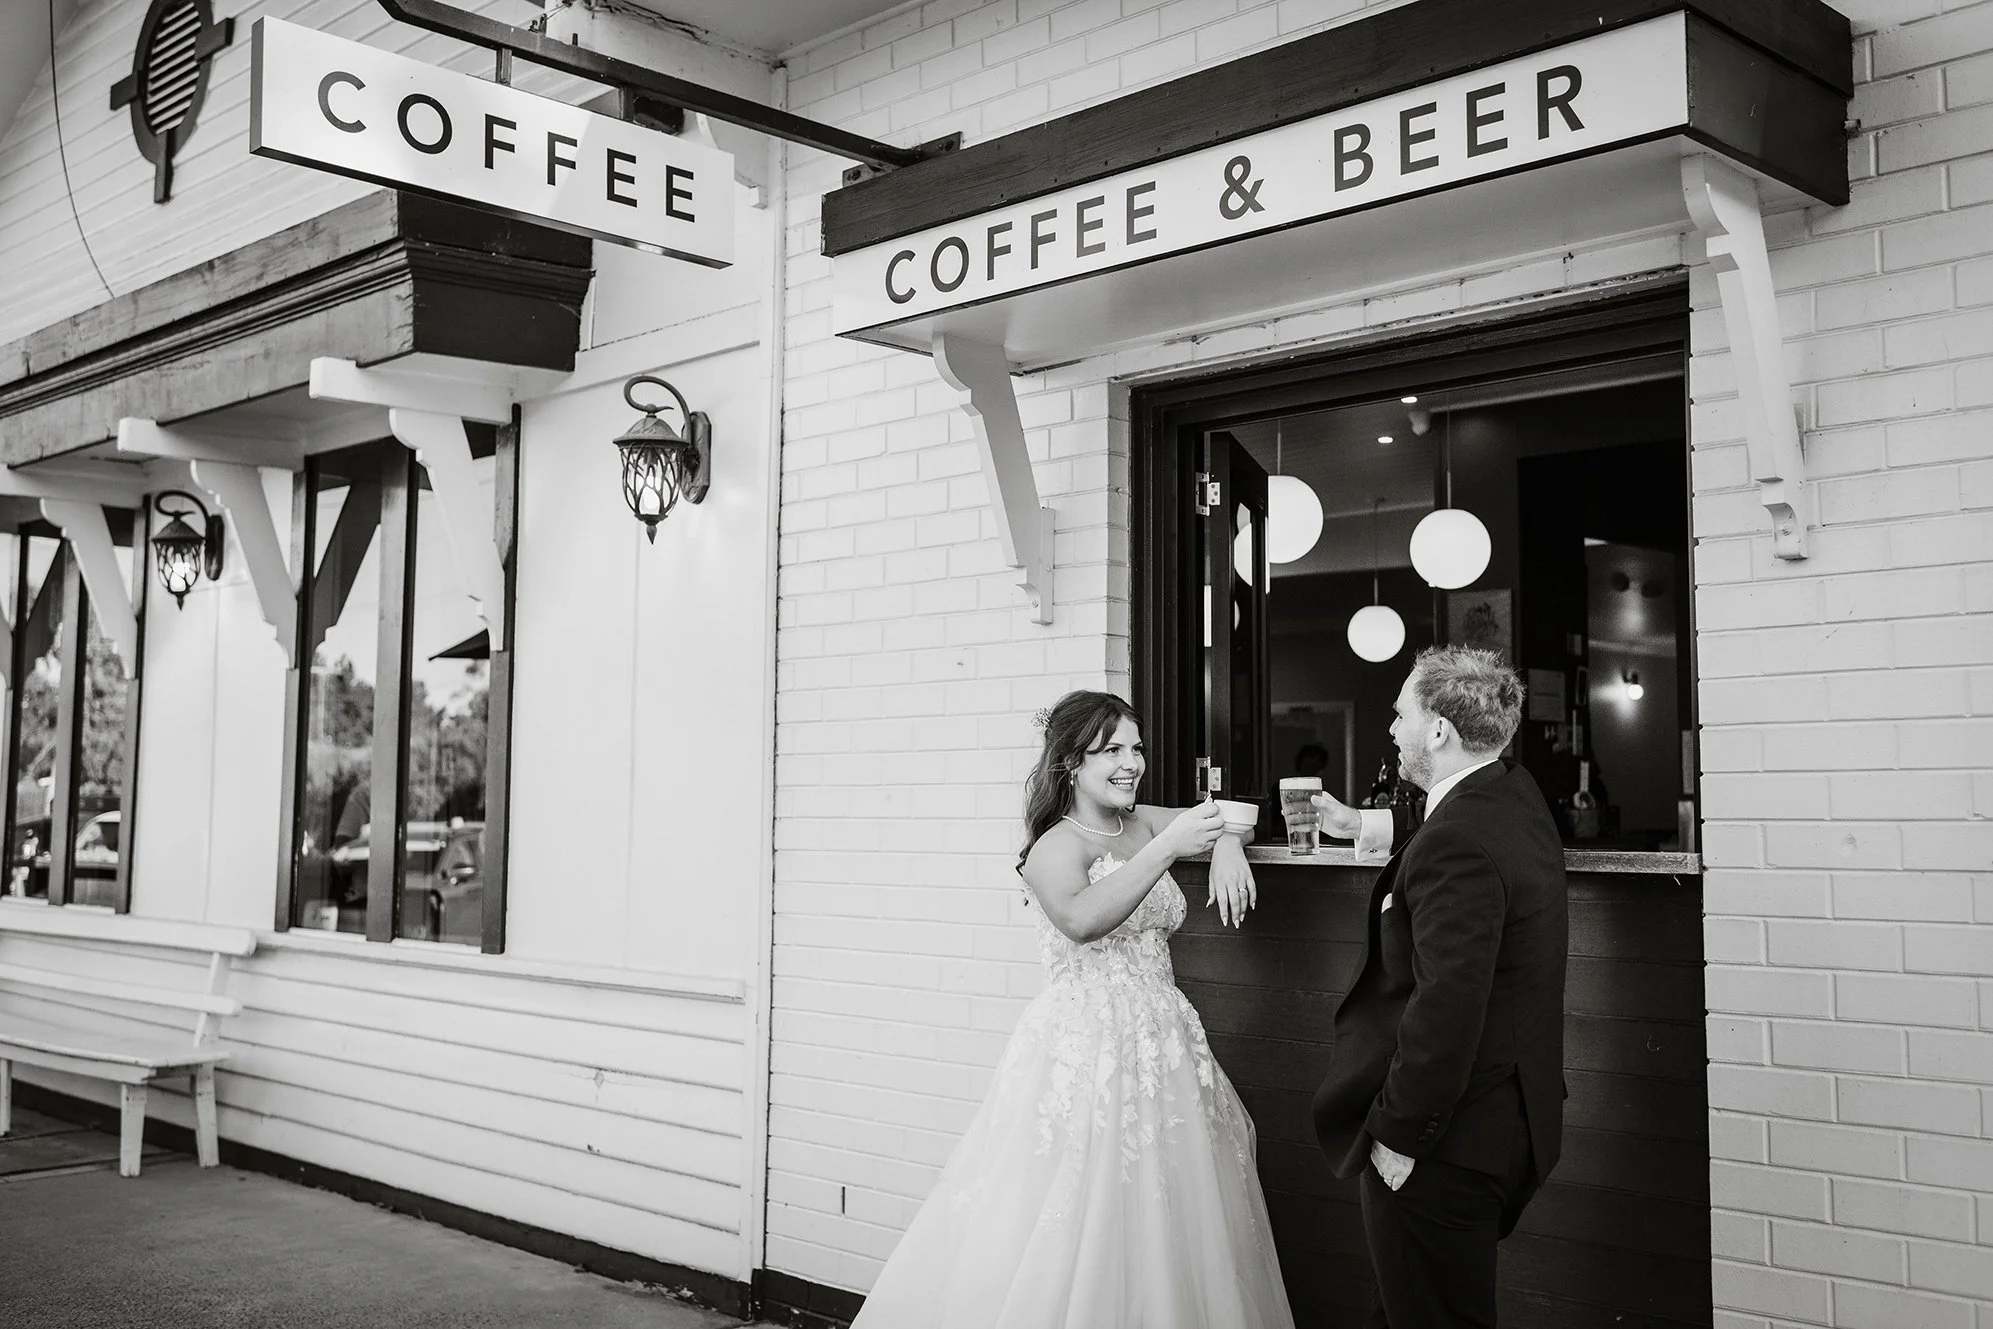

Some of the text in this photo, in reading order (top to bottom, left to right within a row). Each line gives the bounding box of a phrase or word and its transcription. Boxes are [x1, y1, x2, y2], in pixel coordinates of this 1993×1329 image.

[317, 71, 696, 223] COFFEE
[885, 64, 1585, 304] COFFEE & BEER
